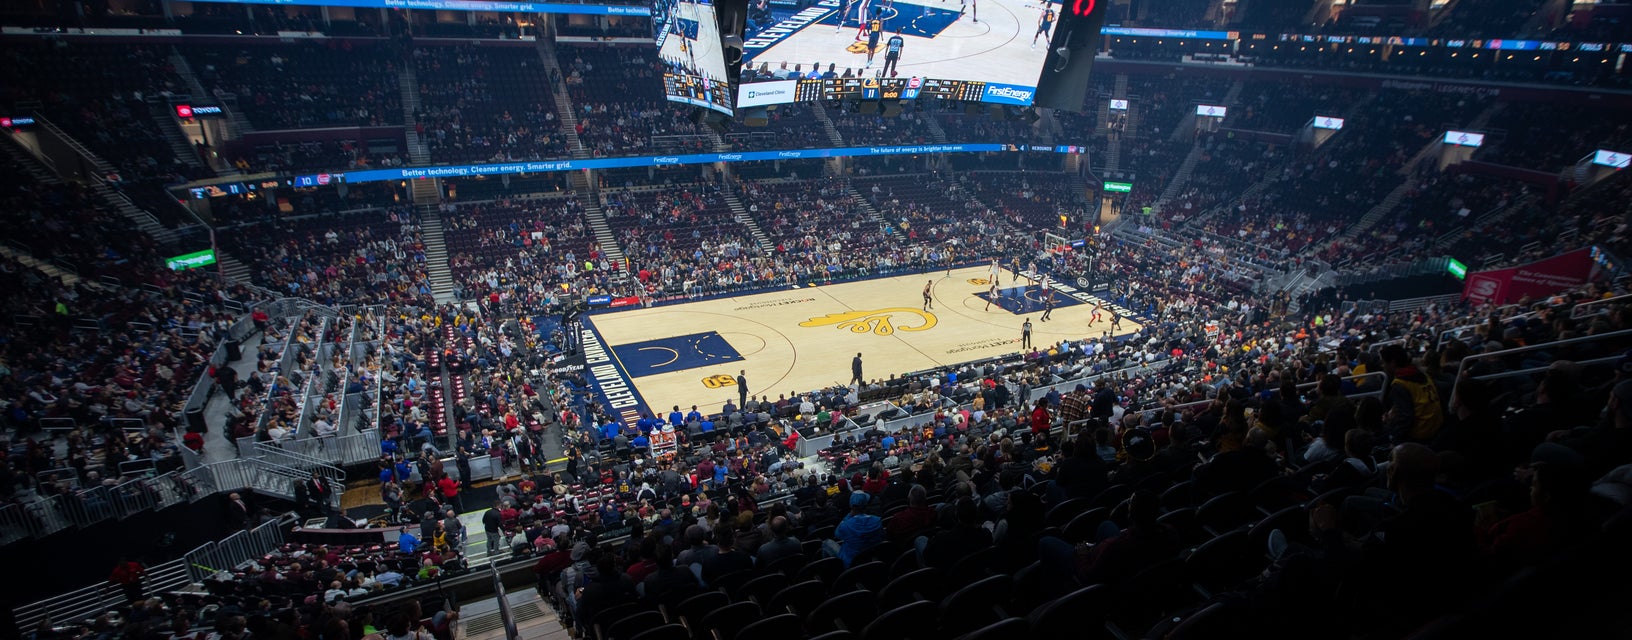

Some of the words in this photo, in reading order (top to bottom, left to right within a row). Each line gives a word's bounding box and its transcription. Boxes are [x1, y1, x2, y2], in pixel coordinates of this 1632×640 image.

[743, 7, 830, 48] CLEVELAND
[868, 90, 874, 98] 11
[906, 89, 915, 97] 10
[988, 86, 1032, 102] FirstEnergy
[428, 166, 470, 176] technology.
[471, 165, 498, 174] Cleaner
[500, 164, 526, 172] energy.
[556, 162, 572, 170] grid.
[302, 177, 312, 186] 10
[591, 364, 638, 408] CLEVELAND
